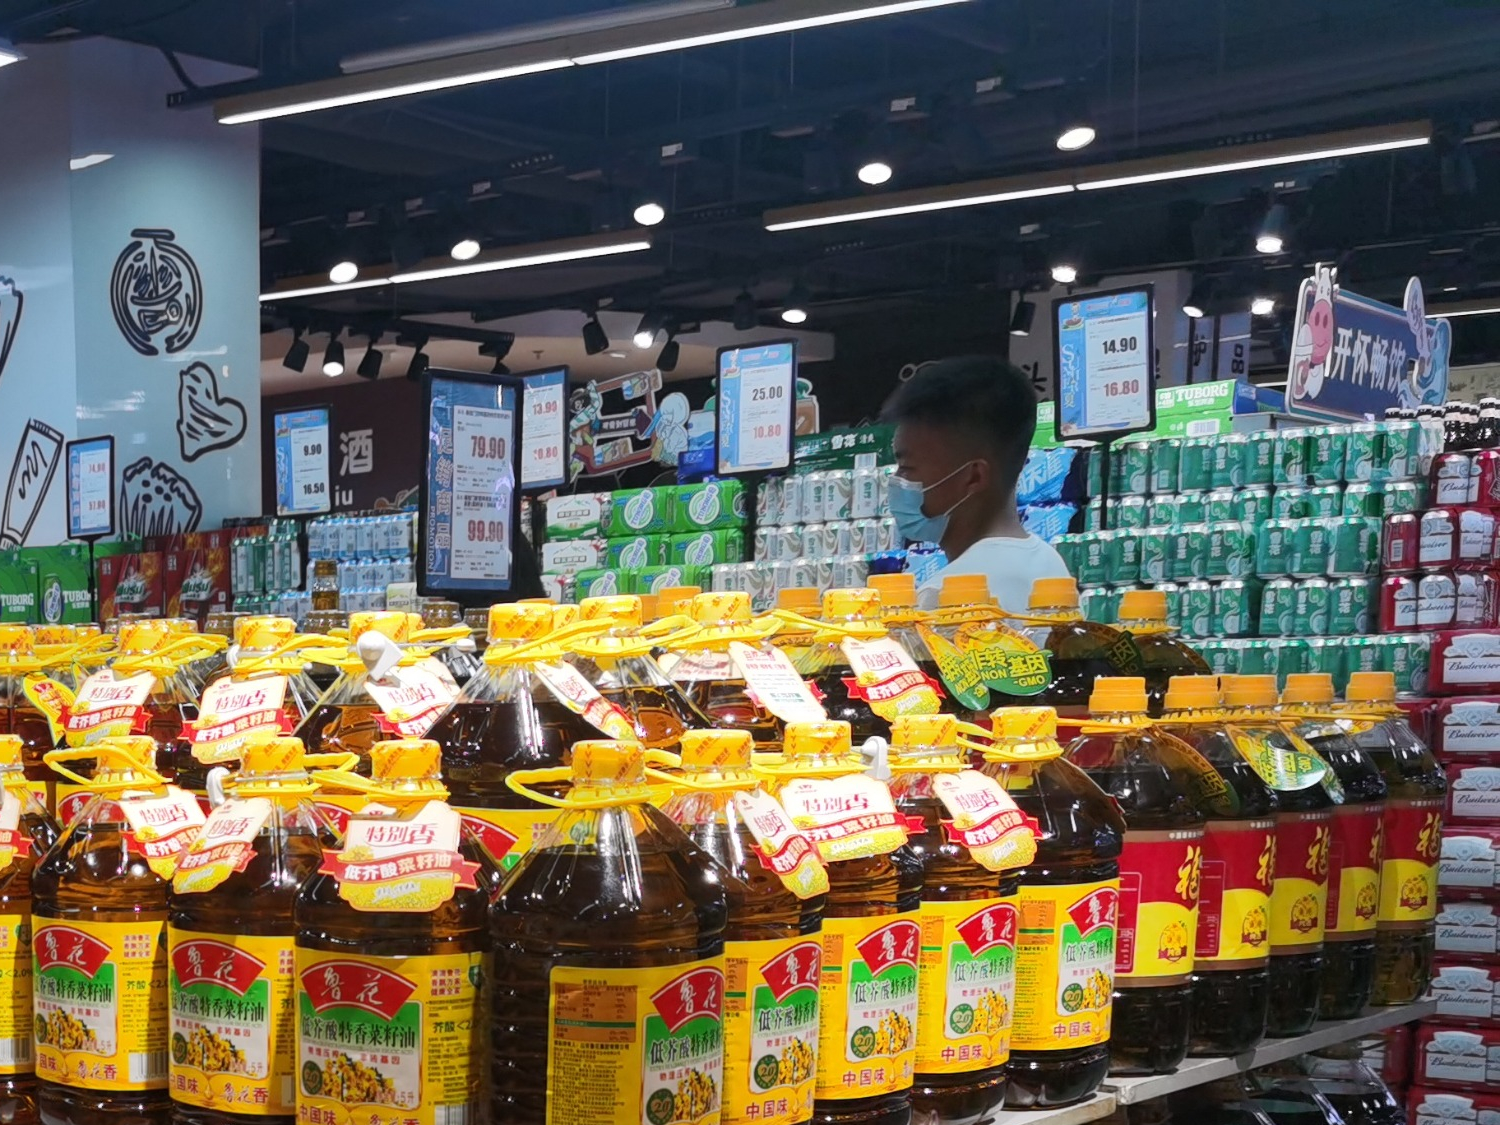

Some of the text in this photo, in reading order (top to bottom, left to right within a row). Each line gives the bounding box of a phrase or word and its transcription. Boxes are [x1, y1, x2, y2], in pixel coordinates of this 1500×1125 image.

[1102, 336, 1137, 354] 14.90
[1330, 327, 1406, 396] 开怀畅饮
[752, 385, 783, 402] 25.00
[1104, 379, 1139, 397] 16.80
[1175, 382, 1229, 403] TUBORG
[753, 424, 781, 440] 10.80
[303, 443, 322, 456] 9.90
[339, 428, 373, 477] 酒
[471, 435, 505, 460] 79.90
[303, 482, 325, 495] 16.50
[335, 485, 353, 506] iu
[468, 519, 504, 543] 99.90
[1, 594, 34, 606] TUBORG
[860, 651, 901, 670] 特别香
[867, 673, 928, 700] 低芥酸菜籽油
[982, 669, 1046, 686] NON -GMO
[90, 685, 139, 701] 特别香
[215, 688, 269, 713] 特别香
[67, 707, 136, 728] 低芥酸菜籽油
[194, 710, 276, 742] 低芥酸菜籽油
[803, 792, 870, 814] 特别香
[954, 792, 998, 812] 特别香
[139, 804, 188, 825] 特别香
[364, 822, 438, 847] 特别香
[963, 813, 1024, 845] 低芥酸菜籽油
[343, 851, 453, 882] 低芥酸菜籽油
[1438, 864, 1493, 875] Budweiser
[1085, 895, 1116, 924] 鲁花
[978, 910, 1014, 941] 鲁花
[1438, 929, 1493, 940] Budweiser
[44, 930, 88, 966] 鲁花
[876, 924, 920, 962] 鲁花
[186, 946, 237, 982] 鲁花
[782, 948, 819, 985] 鲁花
[320, 966, 384, 1005] 鲁花
[676, 976, 718, 1014] 鲁花
[302, 1016, 415, 1049] 低芥酸特香菜籽油
[1054, 1021, 1092, 1039] 中国味
[360, 1053, 400, 1065] 非转基因
[942, 1045, 983, 1063] 中国味
[1429, 1056, 1484, 1069] Budweiser
[659, 1067, 691, 1082] 物理压榨
[760, 1066, 774, 1077] 2.0
[843, 1068, 885, 1086] 中国味
[220, 1083, 268, 1104] 鲁花香
[653, 1101, 670, 1114] 2.0
[746, 1098, 788, 1119] 中国味
